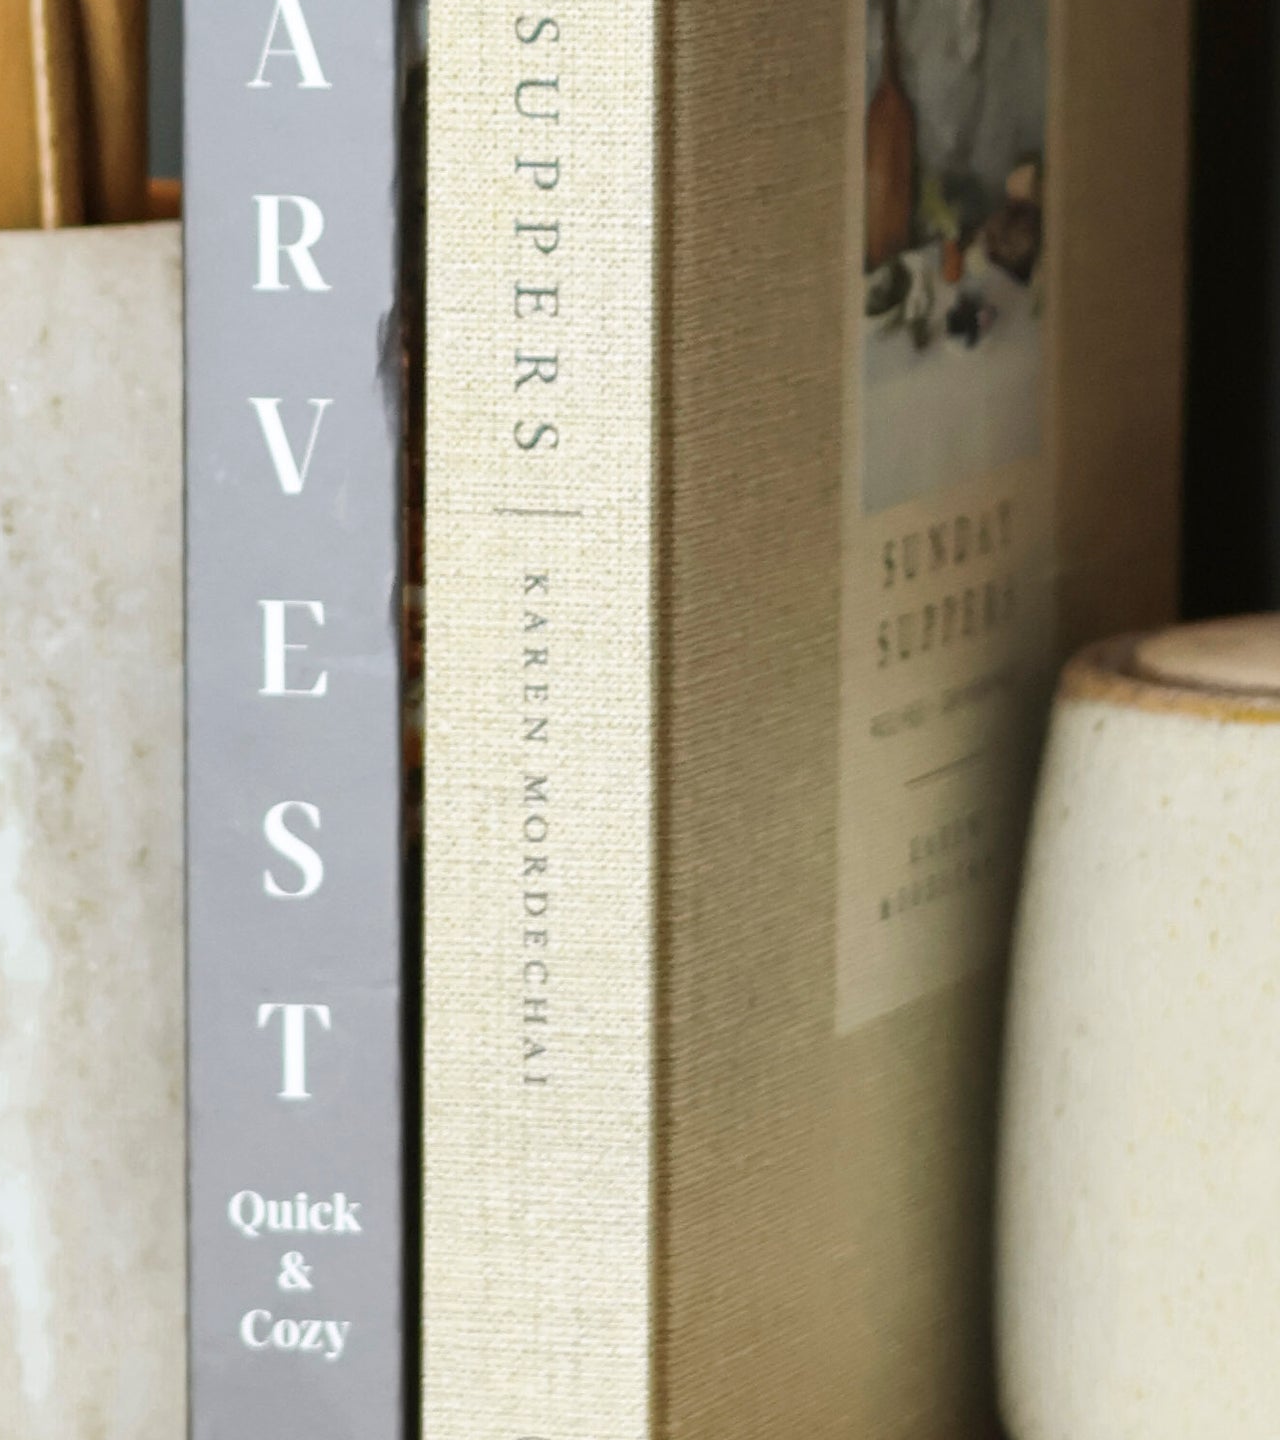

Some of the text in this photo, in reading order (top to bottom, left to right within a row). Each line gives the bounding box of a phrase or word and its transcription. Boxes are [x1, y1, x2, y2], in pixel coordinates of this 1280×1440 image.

[513, 16, 561, 453] SUPPERS
[522, 571, 550, 1088] KAREN MORDECHAI
[228, 1190, 363, 1237] Quick
[276, 1250, 314, 1291] &
[240, 1309, 352, 1358] Cozy
